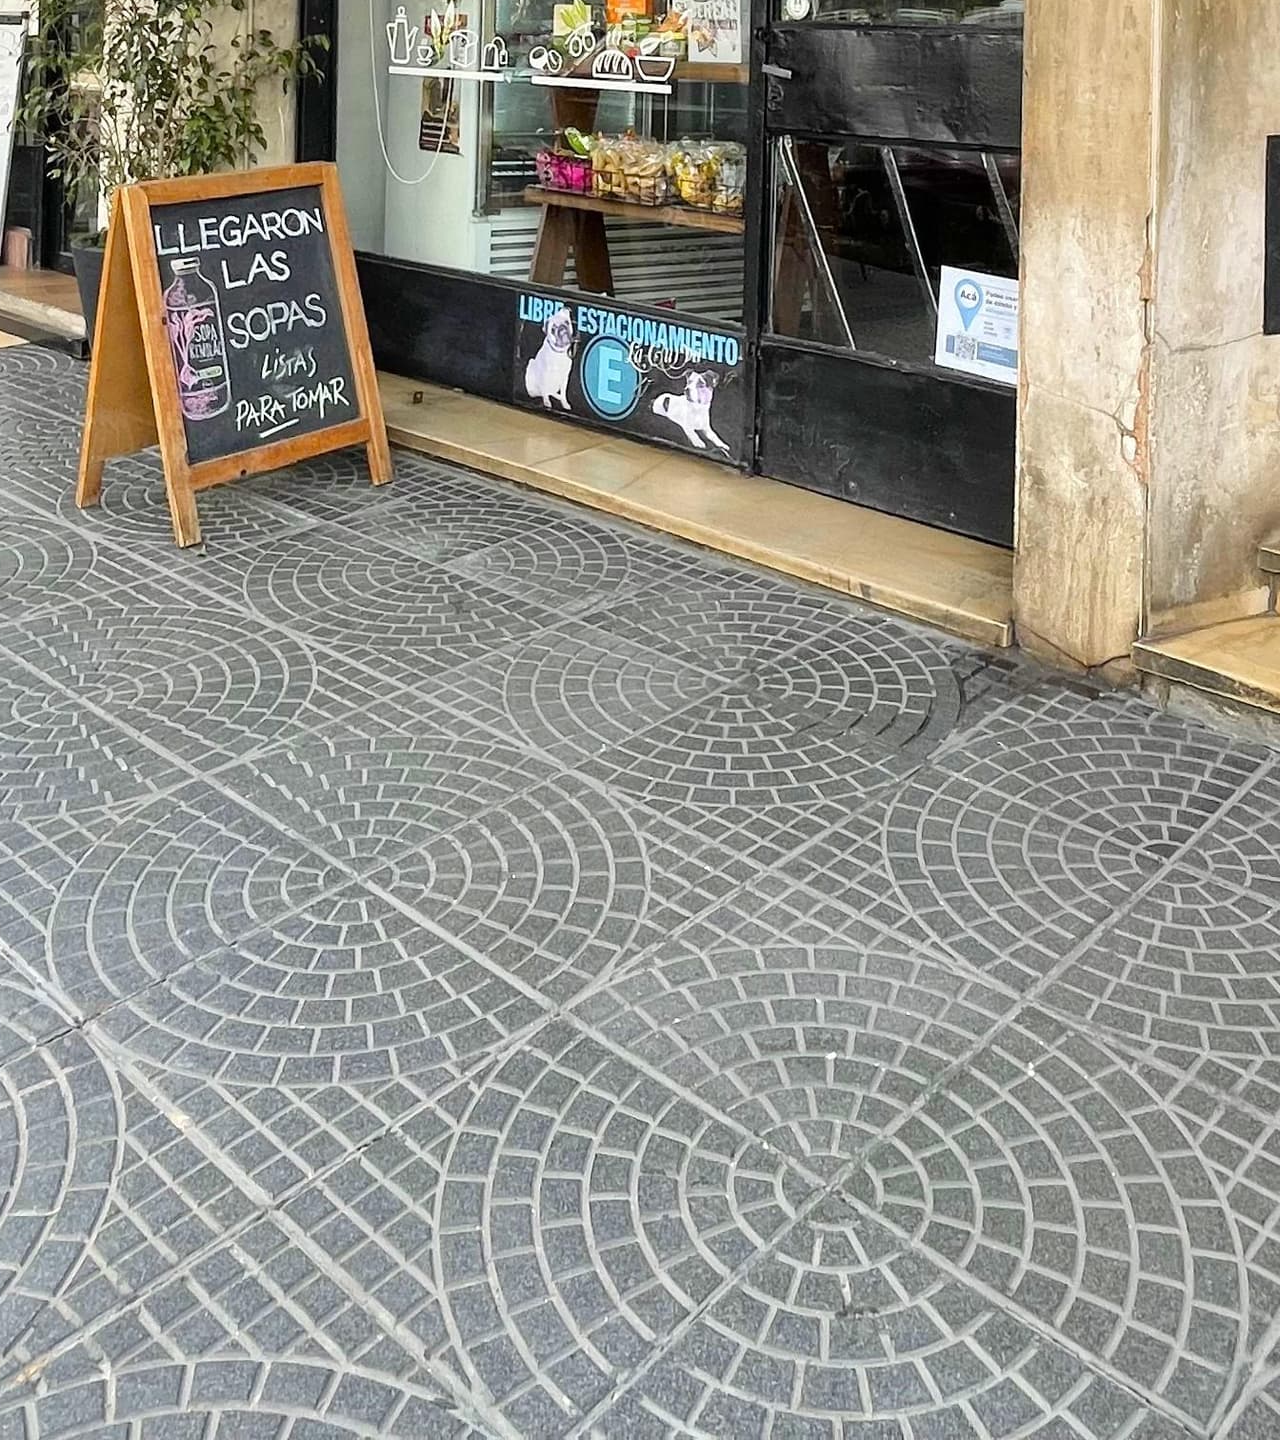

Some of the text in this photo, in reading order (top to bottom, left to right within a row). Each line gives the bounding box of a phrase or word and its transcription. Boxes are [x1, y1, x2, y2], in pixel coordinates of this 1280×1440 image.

[154, 207, 325, 256] LLEGARON
[220, 250, 292, 290] LAS
[960, 289, 978, 301] Acá
[227, 293, 327, 349] SOPAS
[577, 306, 739, 367] ESTACIONAMIENTO
[597, 345, 621, 405] E
[235, 376, 350, 431] PARA TOMAR
